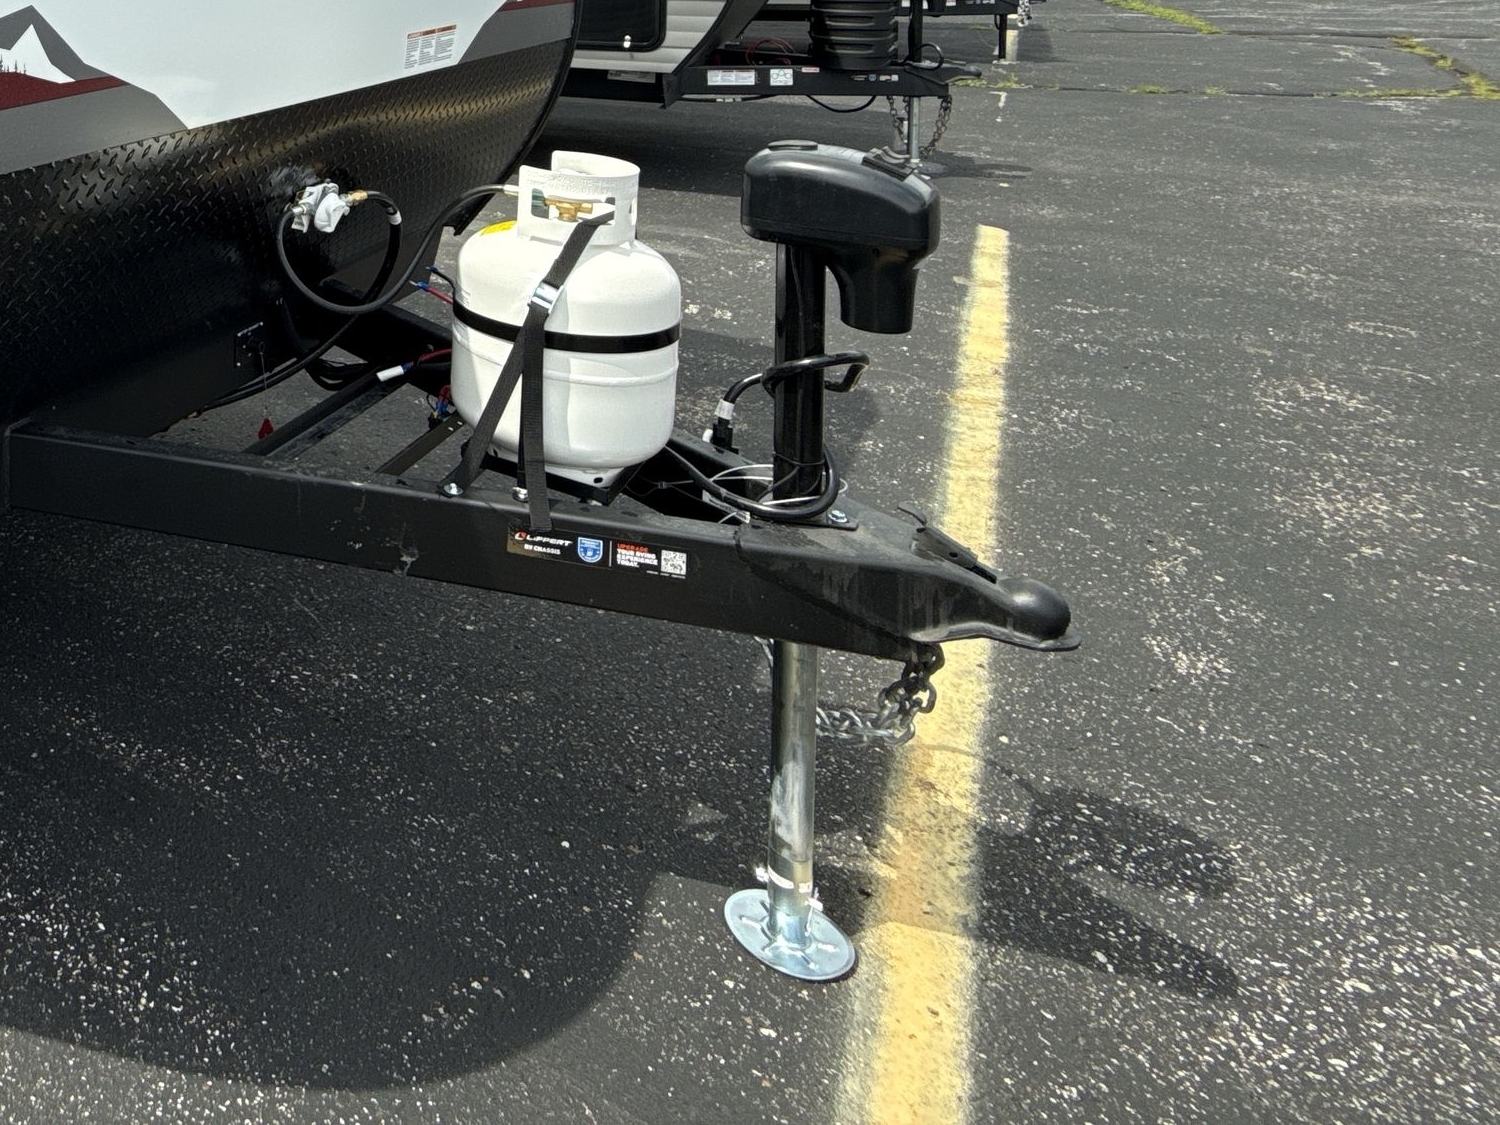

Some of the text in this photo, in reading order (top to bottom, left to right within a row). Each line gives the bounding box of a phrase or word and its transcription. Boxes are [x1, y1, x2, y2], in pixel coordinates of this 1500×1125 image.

[526, 534, 573, 547] LIPPERT
[533, 545, 561, 555] CHASSIS
[616, 543, 649, 553] UPGRADE
